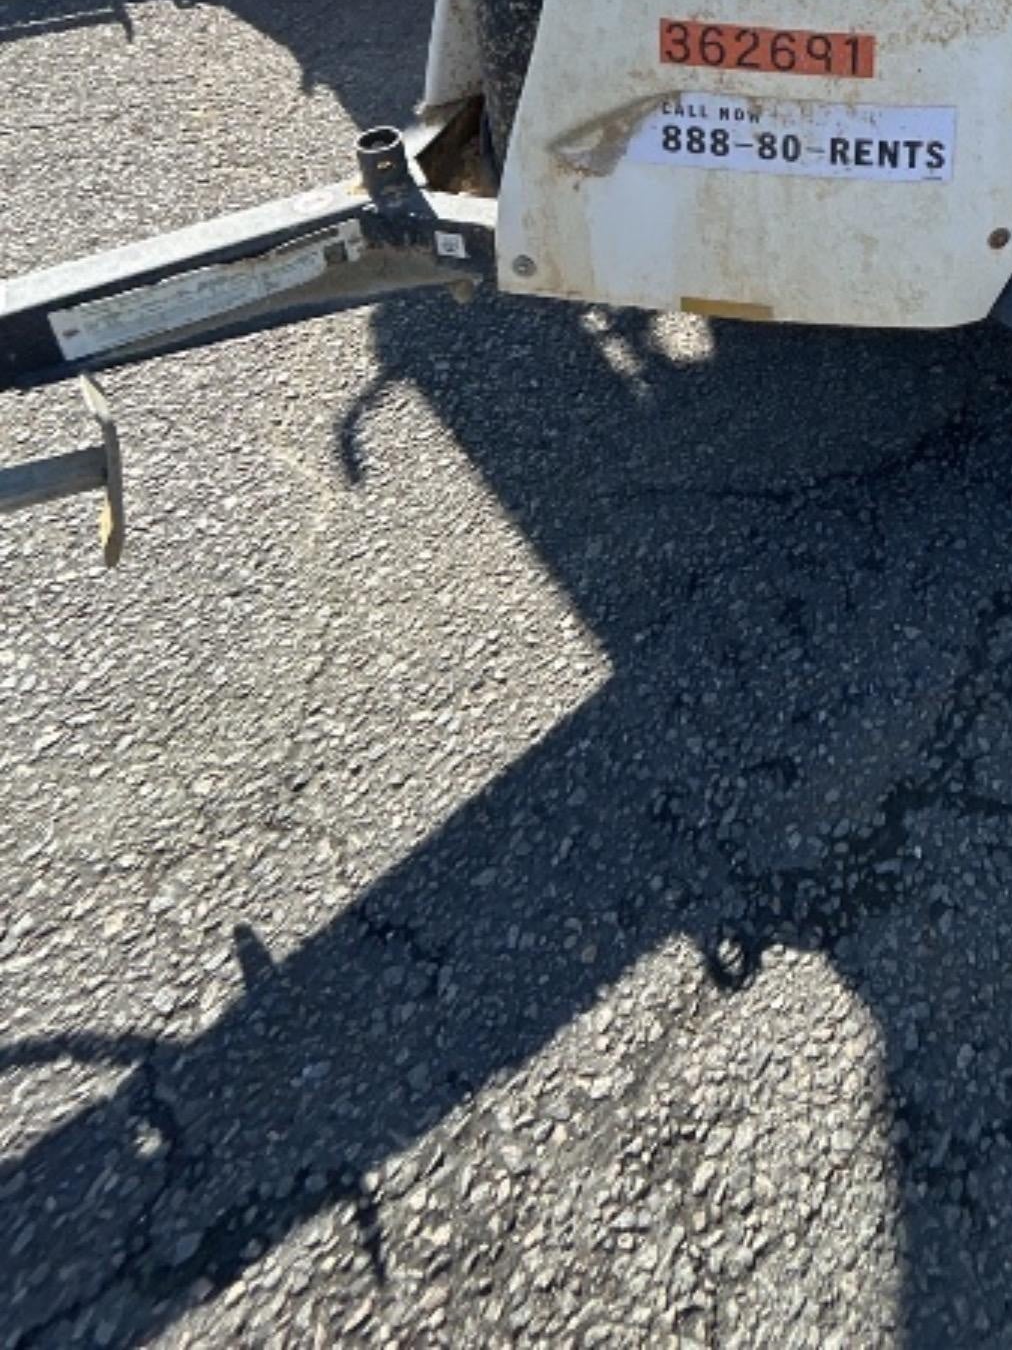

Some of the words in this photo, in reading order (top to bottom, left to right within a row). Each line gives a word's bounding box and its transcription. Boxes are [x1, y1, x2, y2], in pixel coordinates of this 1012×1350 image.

[665, 22, 861, 75] 362691
[662, 101, 709, 118] CALL
[662, 125, 946, 169] 888-80-RENTS
